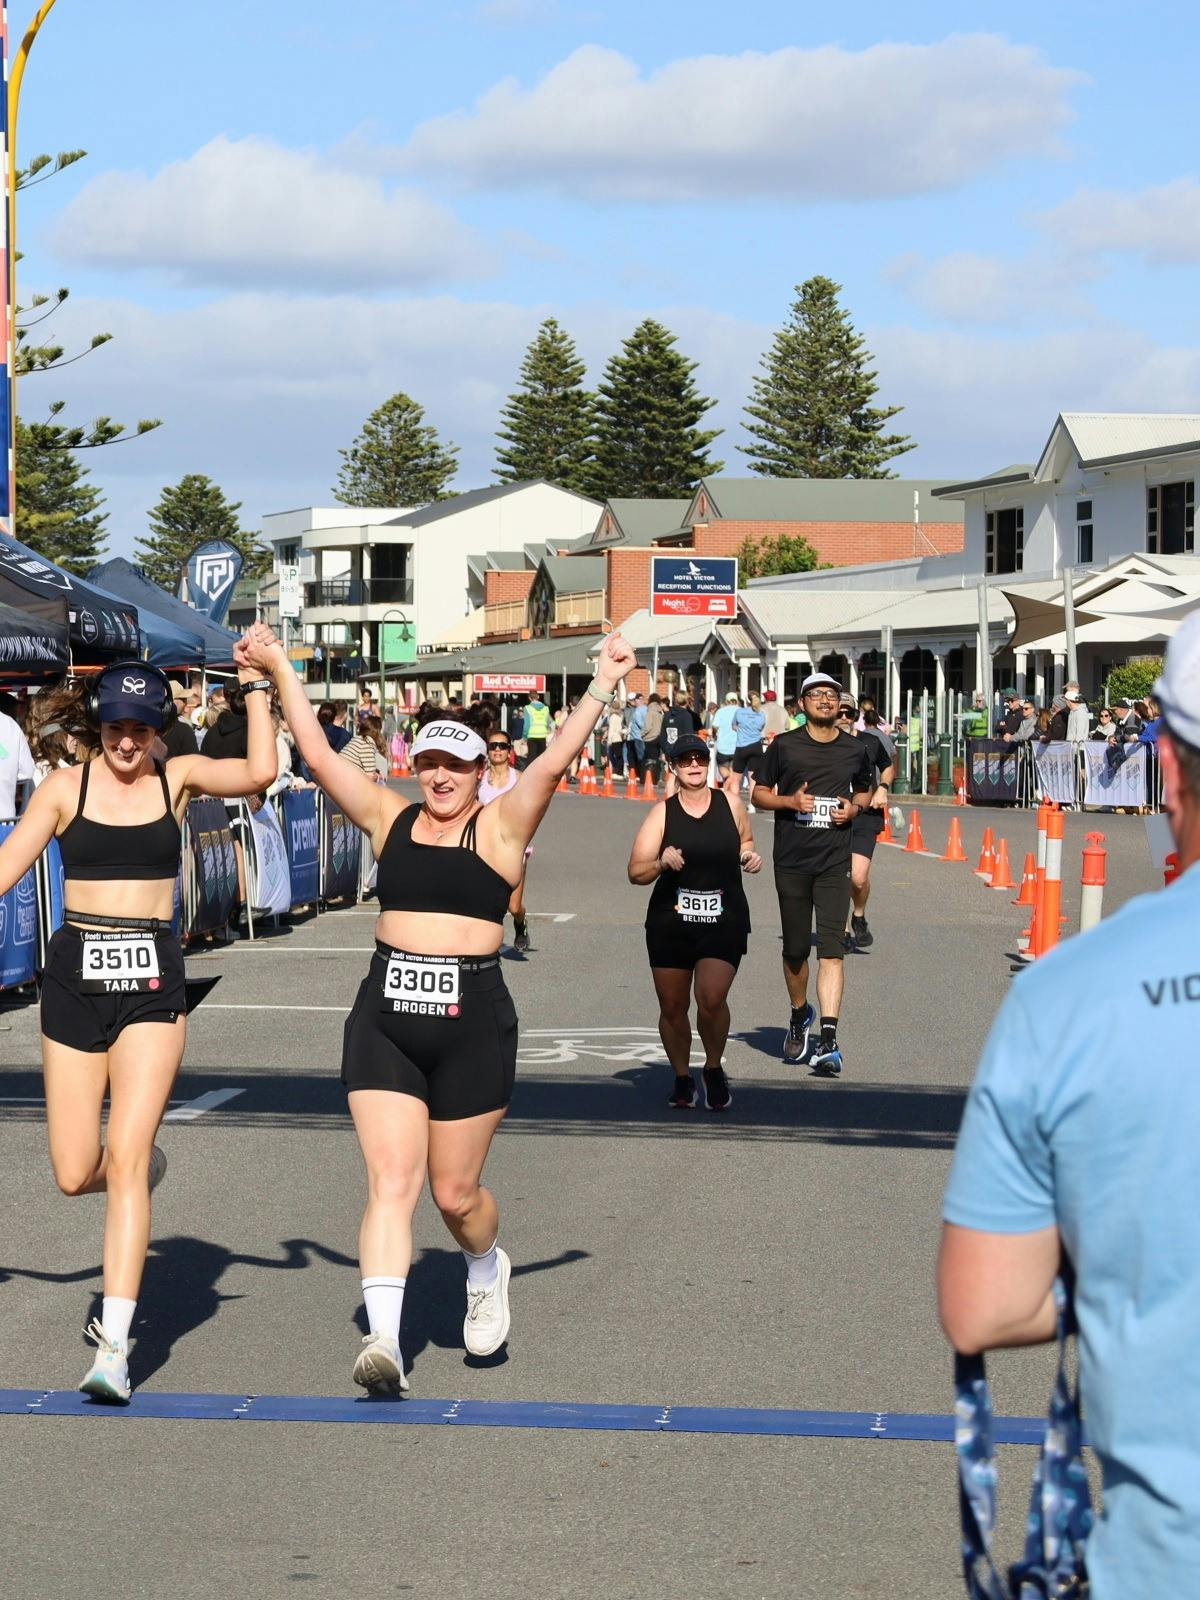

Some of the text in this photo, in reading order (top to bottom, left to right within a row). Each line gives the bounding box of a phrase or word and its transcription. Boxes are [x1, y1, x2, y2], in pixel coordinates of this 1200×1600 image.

[662, 598, 686, 610] Night
[482, 674, 536, 686] Red Orchid
[682, 897, 718, 911] 3612
[683, 915, 717, 923] BELINDA
[90, 947, 151, 970] 3510
[104, 980, 139, 991] TARA
[389, 967, 454, 993] 3306
[393, 1000, 446, 1016] BROGEN
